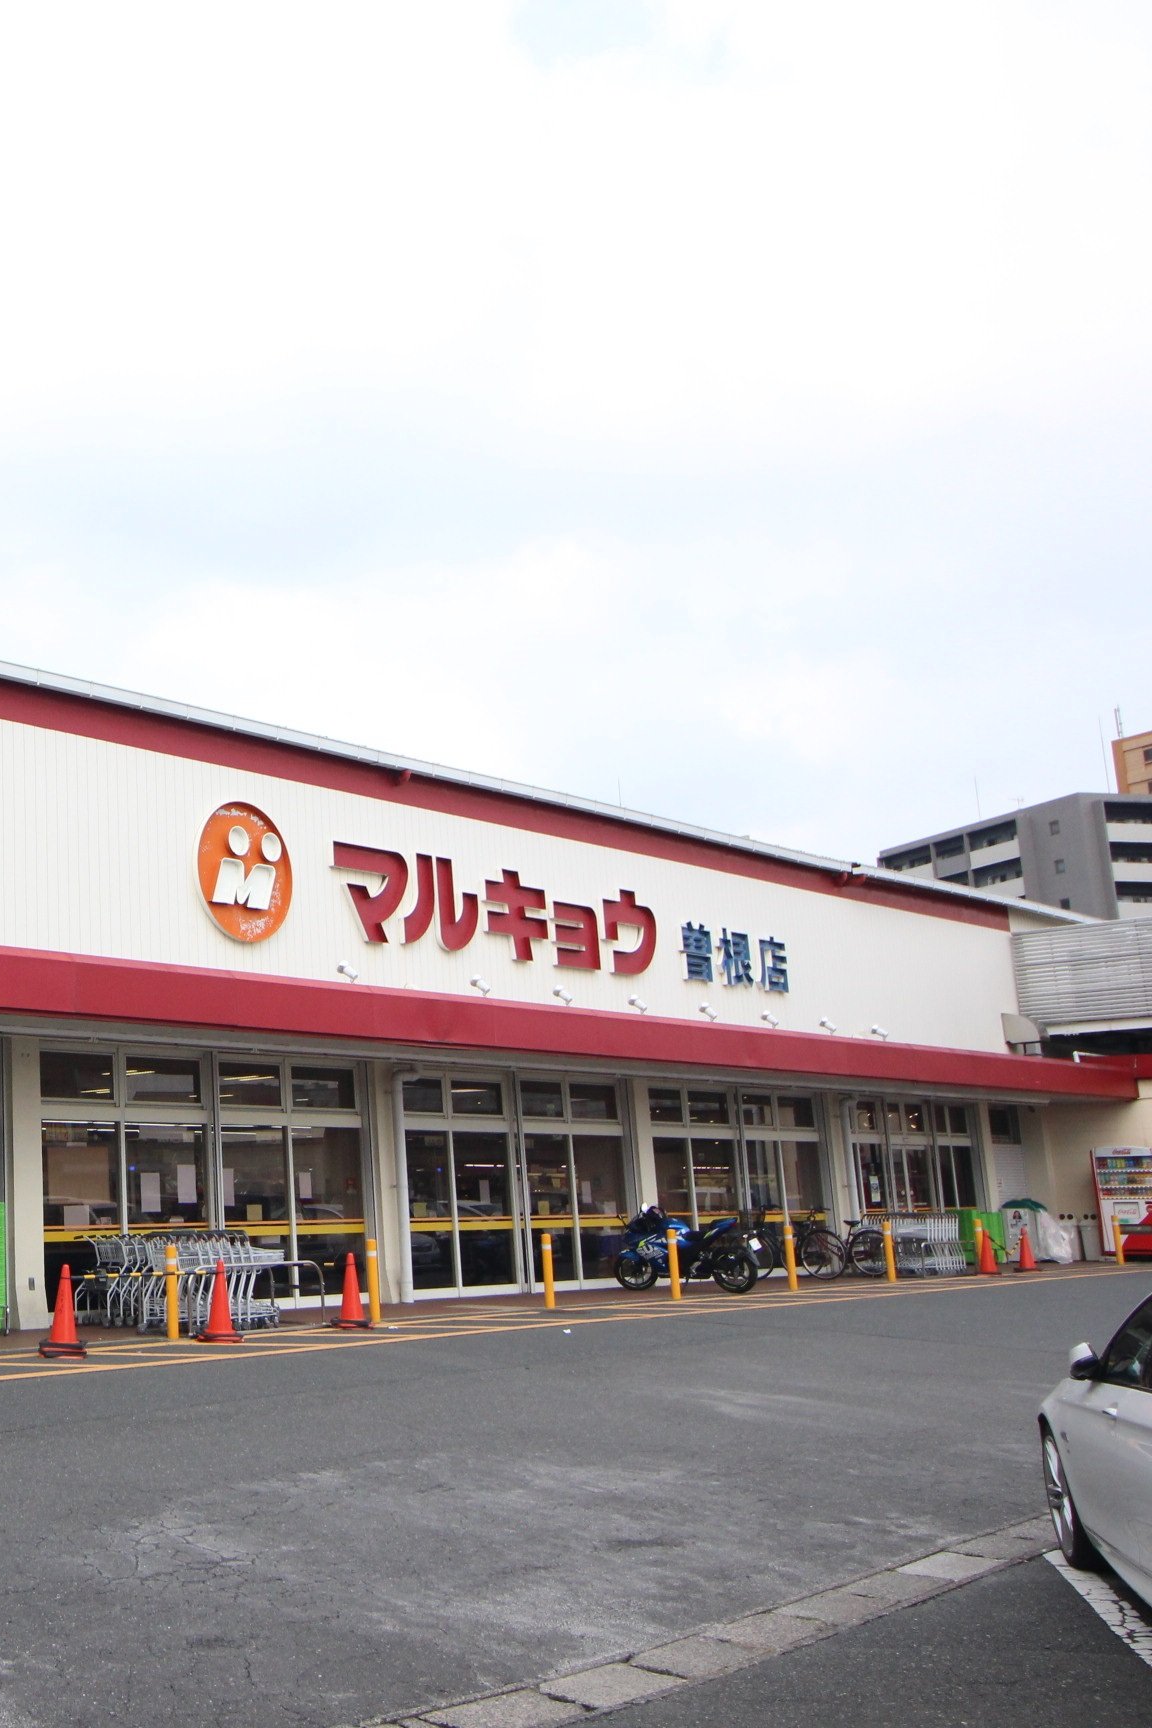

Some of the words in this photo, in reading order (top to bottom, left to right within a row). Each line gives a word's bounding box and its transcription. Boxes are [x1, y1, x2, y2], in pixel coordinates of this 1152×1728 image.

[330, 840, 656, 976] マルキョウ
[680, 921, 790, 994] 曽根店
